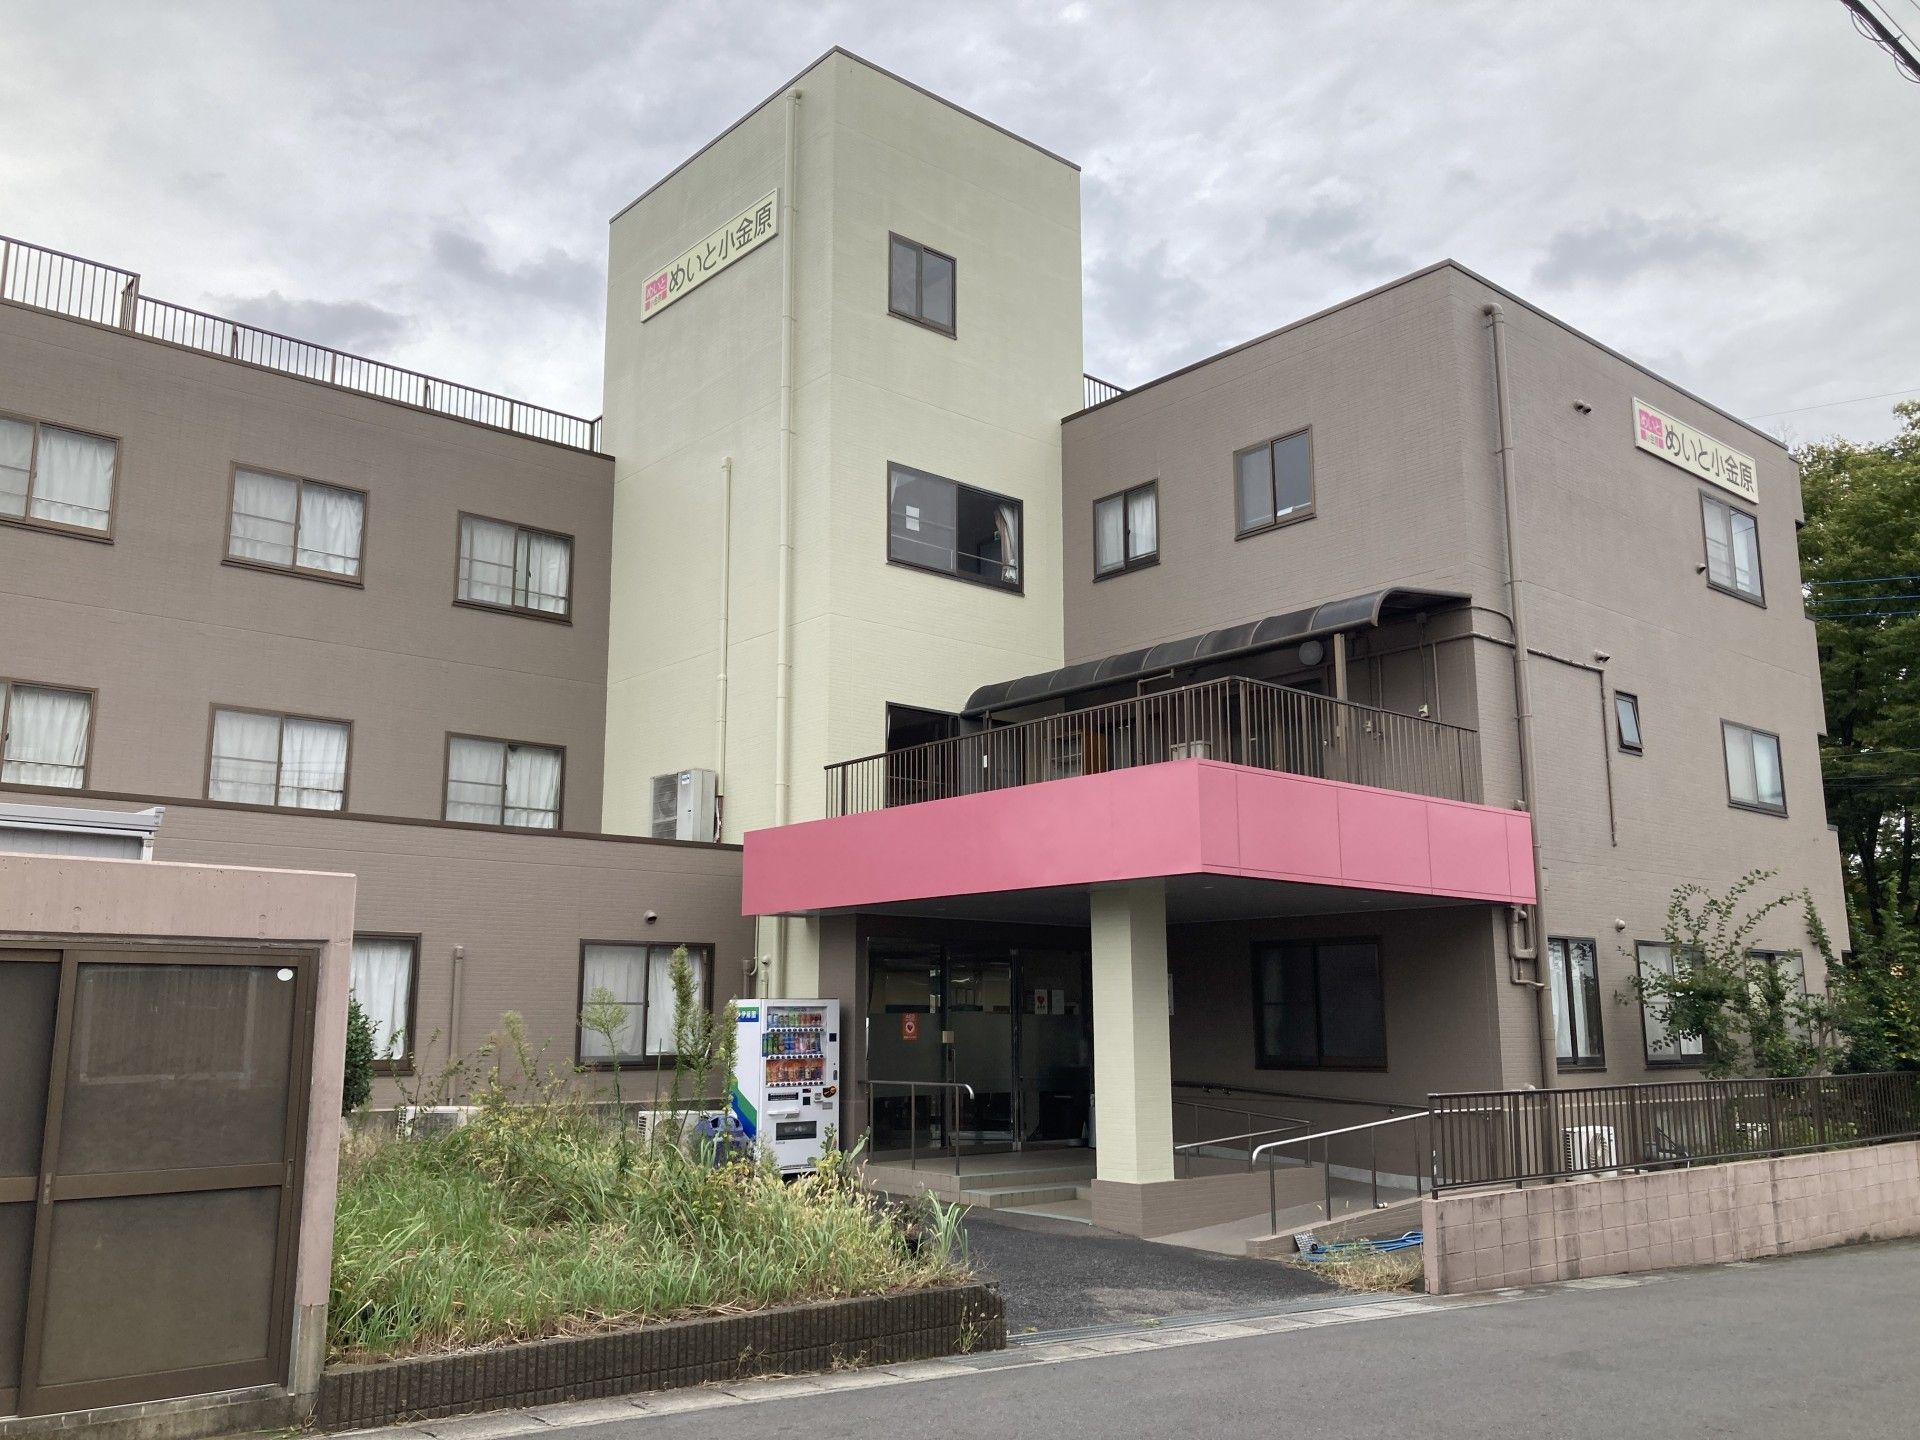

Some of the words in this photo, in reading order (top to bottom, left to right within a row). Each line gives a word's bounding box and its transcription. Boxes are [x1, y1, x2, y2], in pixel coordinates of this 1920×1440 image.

[669, 201, 773, 293] めいと小金原
[1665, 424, 1755, 494] めいと小金原
